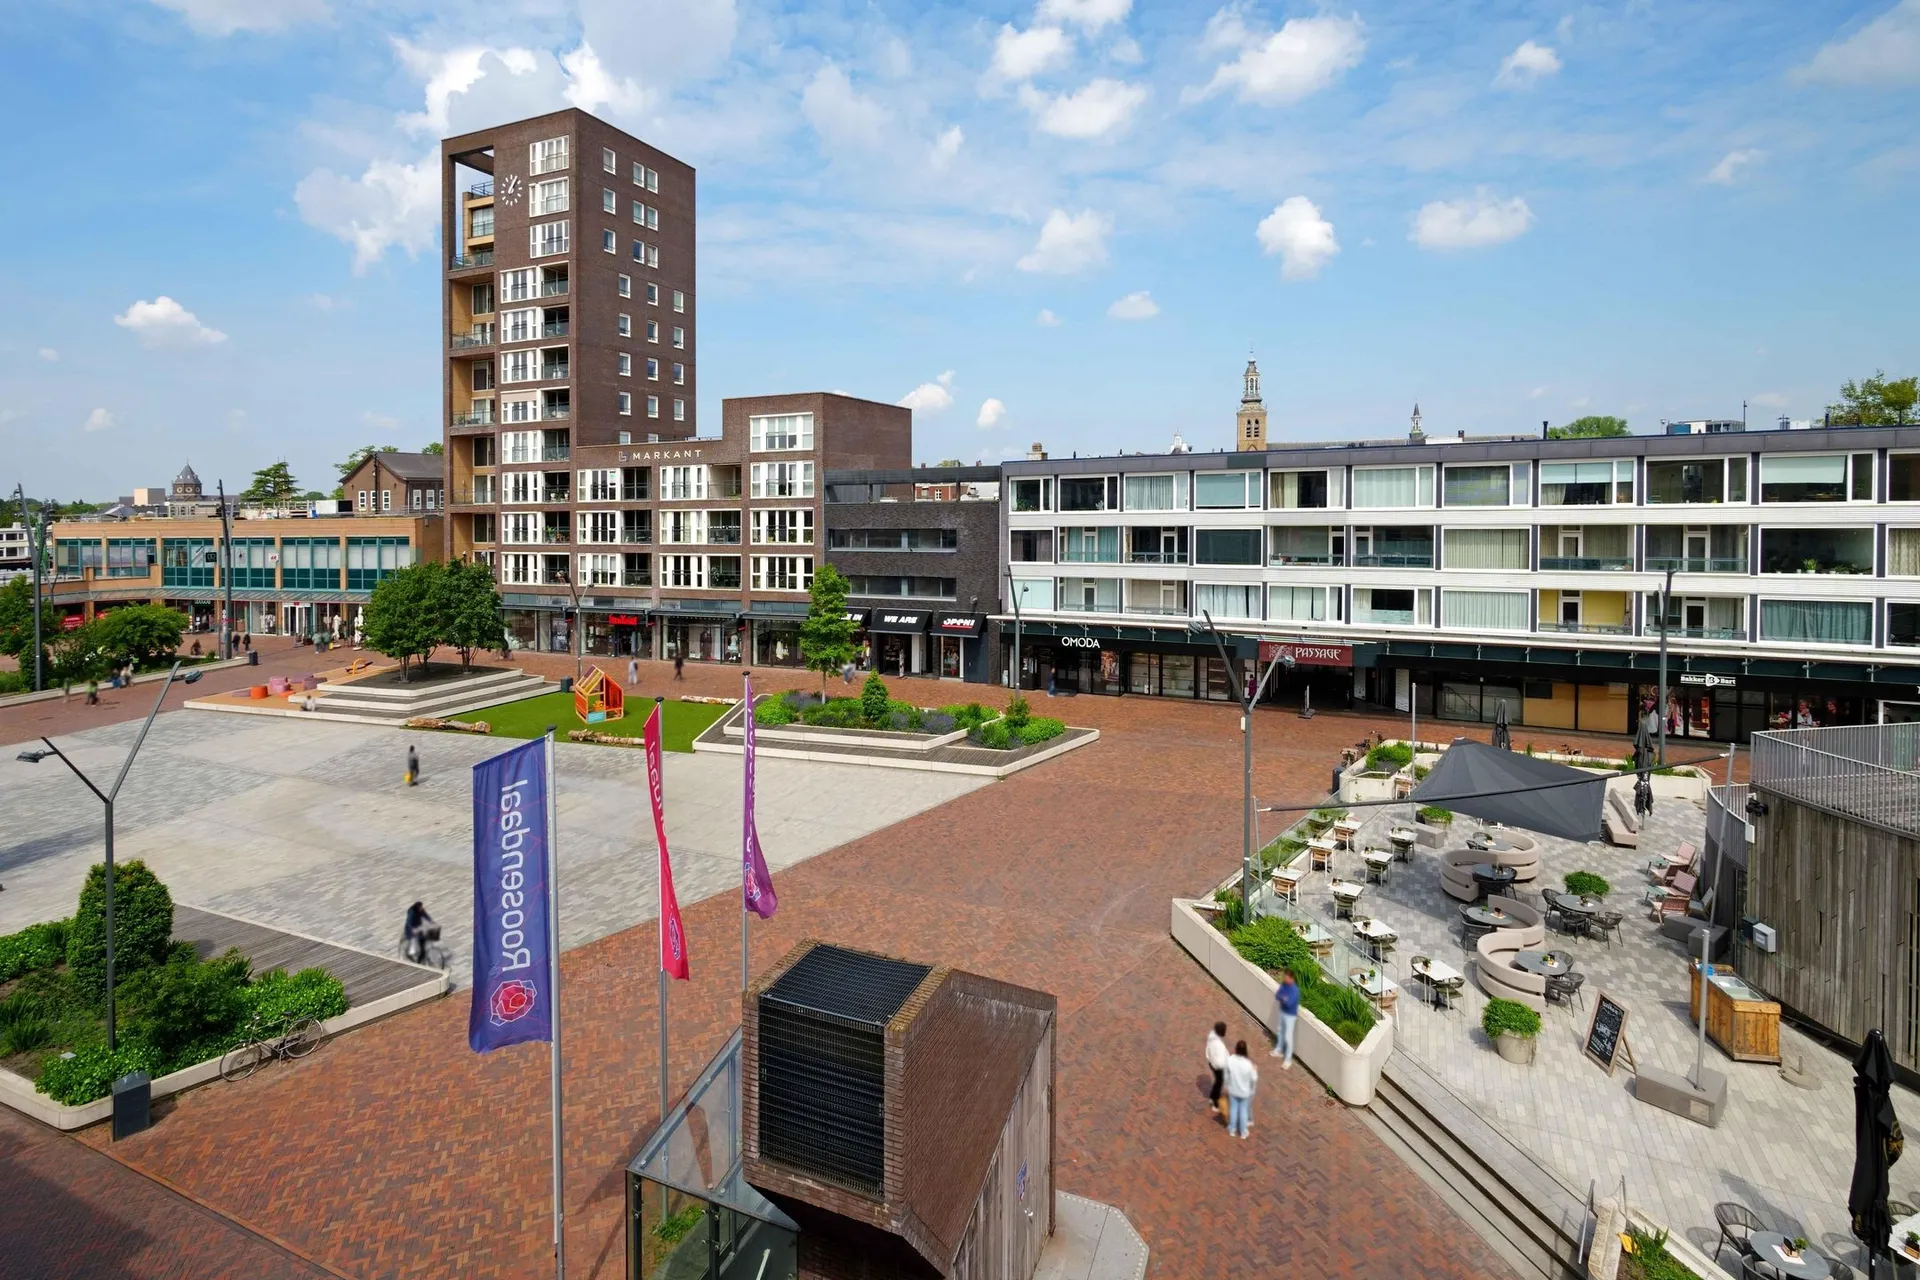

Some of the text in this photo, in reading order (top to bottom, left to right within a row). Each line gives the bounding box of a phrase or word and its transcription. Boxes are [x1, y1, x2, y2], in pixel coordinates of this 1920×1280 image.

[632, 449, 702, 460] MARKANT
[884, 615, 918, 624] WE ARE
[1061, 636, 1100, 649] OMODA
[1295, 647, 1341, 661] PASSAGE
[1680, 675, 1705, 683] Bakker
